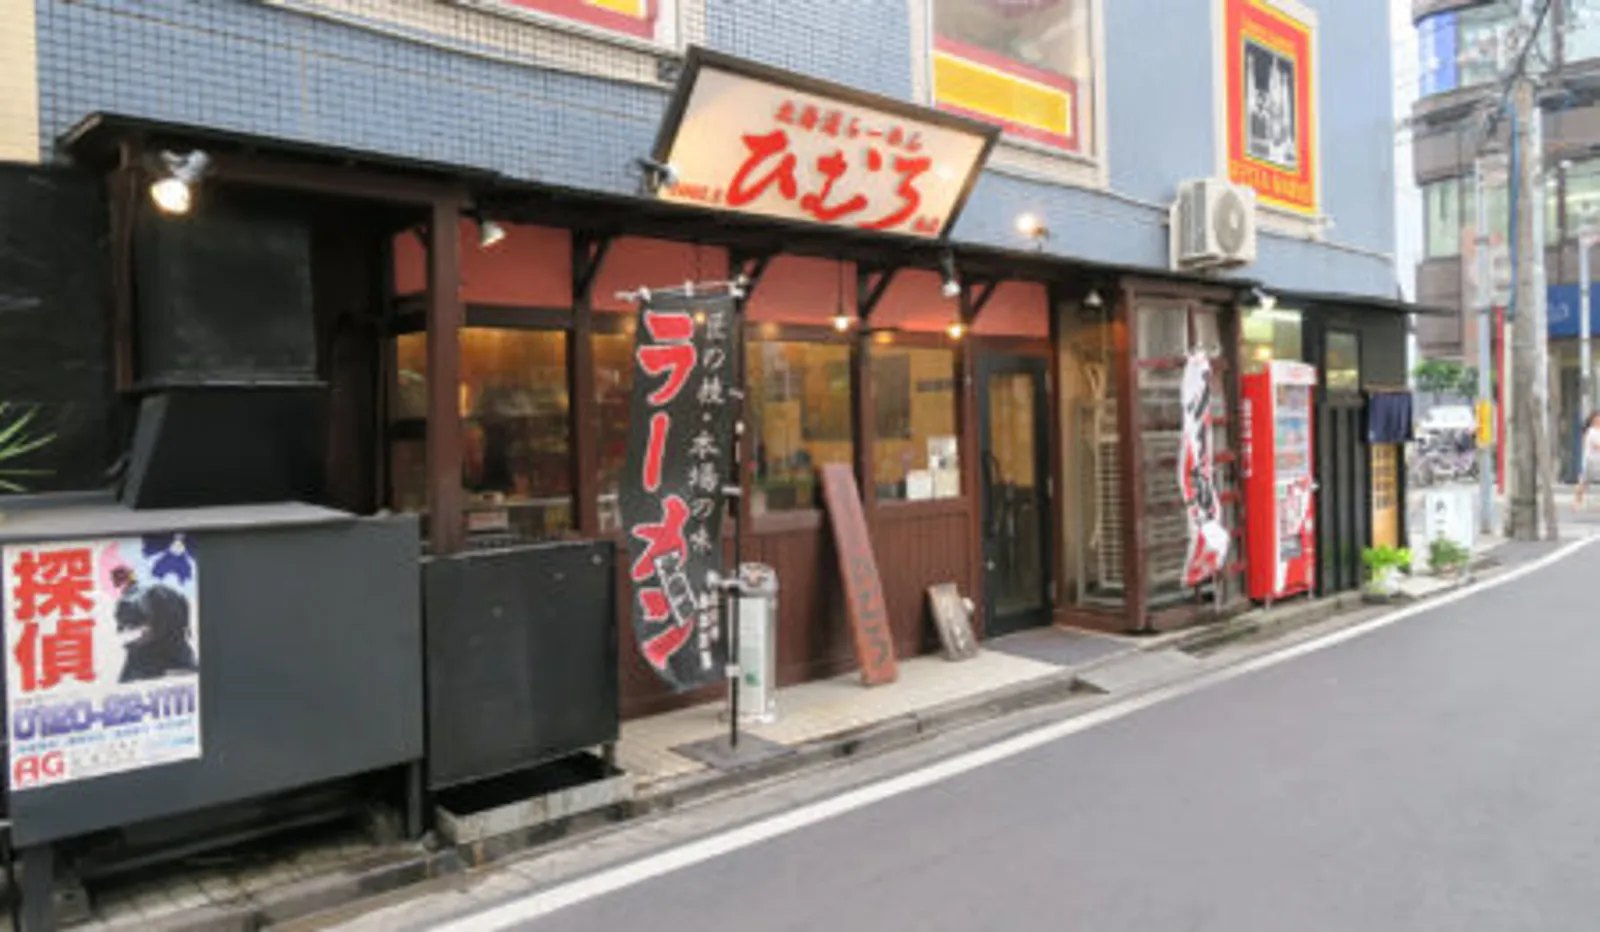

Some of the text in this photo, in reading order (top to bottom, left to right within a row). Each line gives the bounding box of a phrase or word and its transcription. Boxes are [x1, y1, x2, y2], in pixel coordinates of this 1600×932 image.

[725, 129, 932, 230] ひむろ
[632, 310, 698, 671] ラーメン
[13, 547, 96, 693] 探偵
[14, 751, 65, 786] AG
